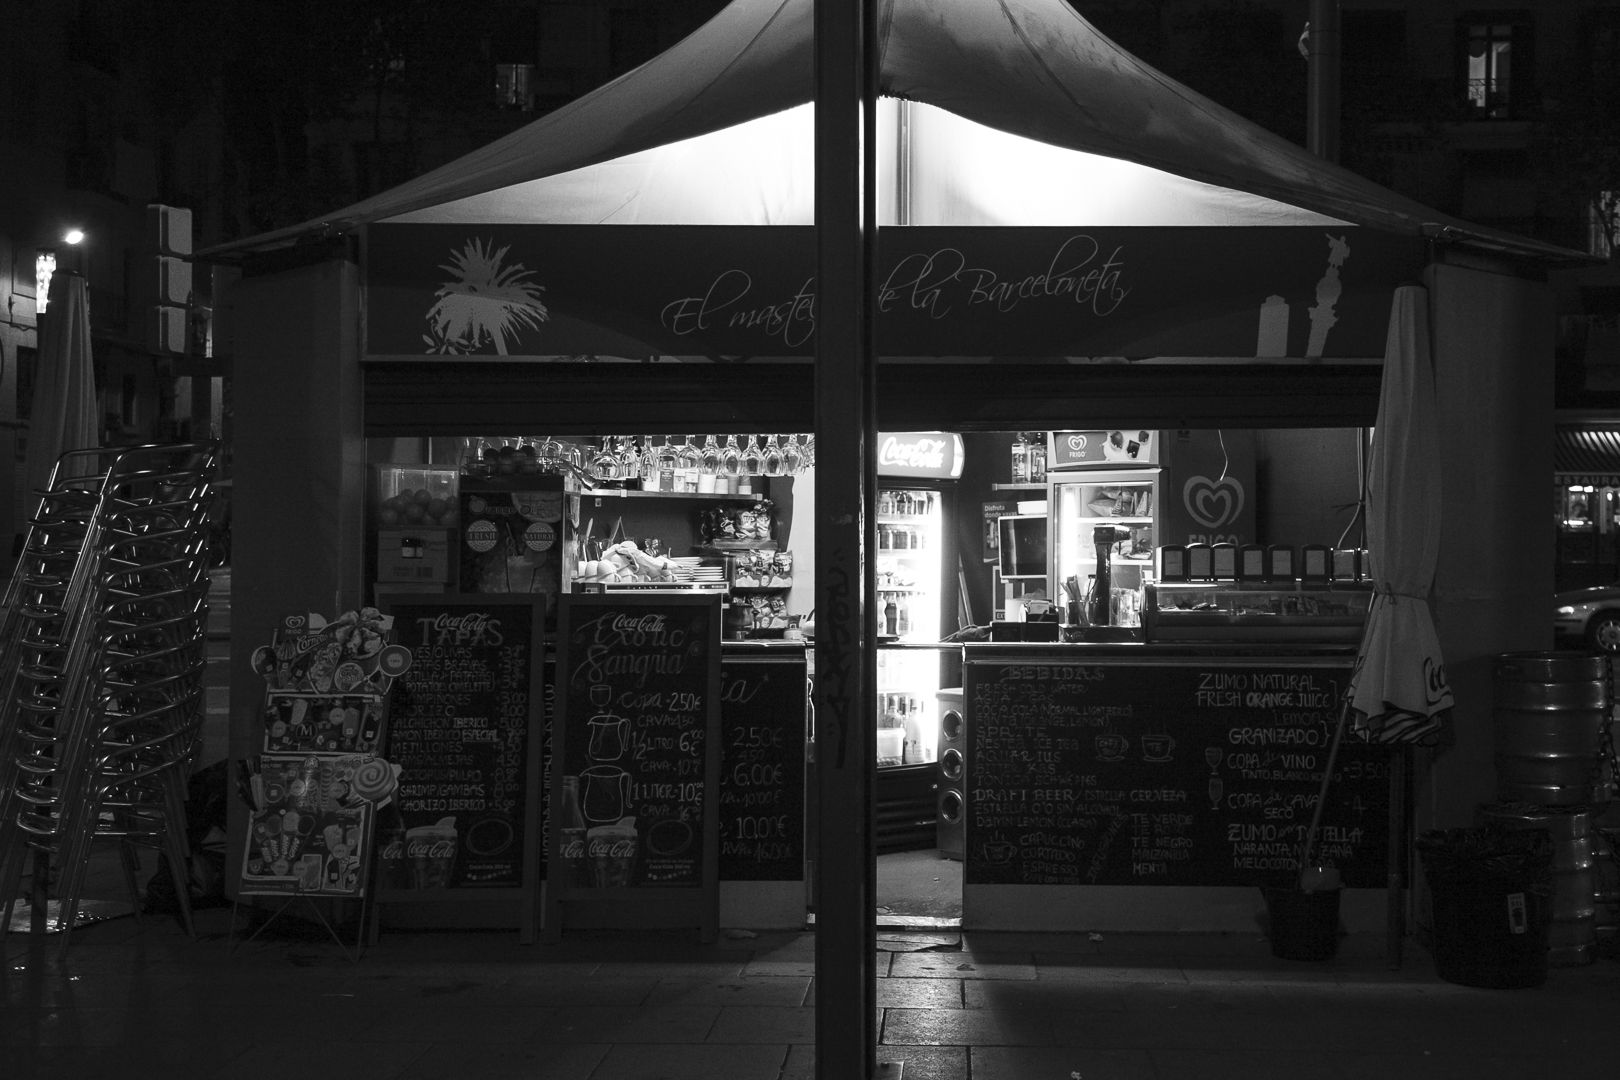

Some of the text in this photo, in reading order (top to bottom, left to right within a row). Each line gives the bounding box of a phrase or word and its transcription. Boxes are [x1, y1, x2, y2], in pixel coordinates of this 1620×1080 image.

[661, 269, 752, 335] El
[729, 276, 817, 348] maste
[911, 247, 966, 320] la
[955, 234, 1129, 316] Barceloneta
[1554, 475, 1620, 486] ESTAURA
[469, 532, 496, 541] FRESH
[434, 612, 490, 632] Coca-Cola
[612, 613, 667, 632] Coca-Cola
[416, 617, 504, 646] TAPAS
[1000, 665, 1105, 683] BEBIDAS
[1199, 672, 1320, 692] ZUMO NATURAL
[1195, 690, 1331, 709] FRESH ORANGE JUICE
[1228, 727, 1320, 745] GRANIZADO
[1226, 753, 1261, 769] COPA
[1281, 754, 1316, 770] VINO
[400, 784, 487, 798] SHRIMP/GAMBAS
[1129, 788, 1187, 802] CERVEZA
[1227, 792, 1262, 809] COPA
[1131, 812, 1194, 826] TE VERDE
[1263, 807, 1295, 820] SECO
[1227, 822, 1277, 842] ZUMO
[588, 839, 636, 859] Coca-Cola
[1131, 836, 1194, 849] TE NEGRO
[1132, 861, 1168, 876] MENTA
